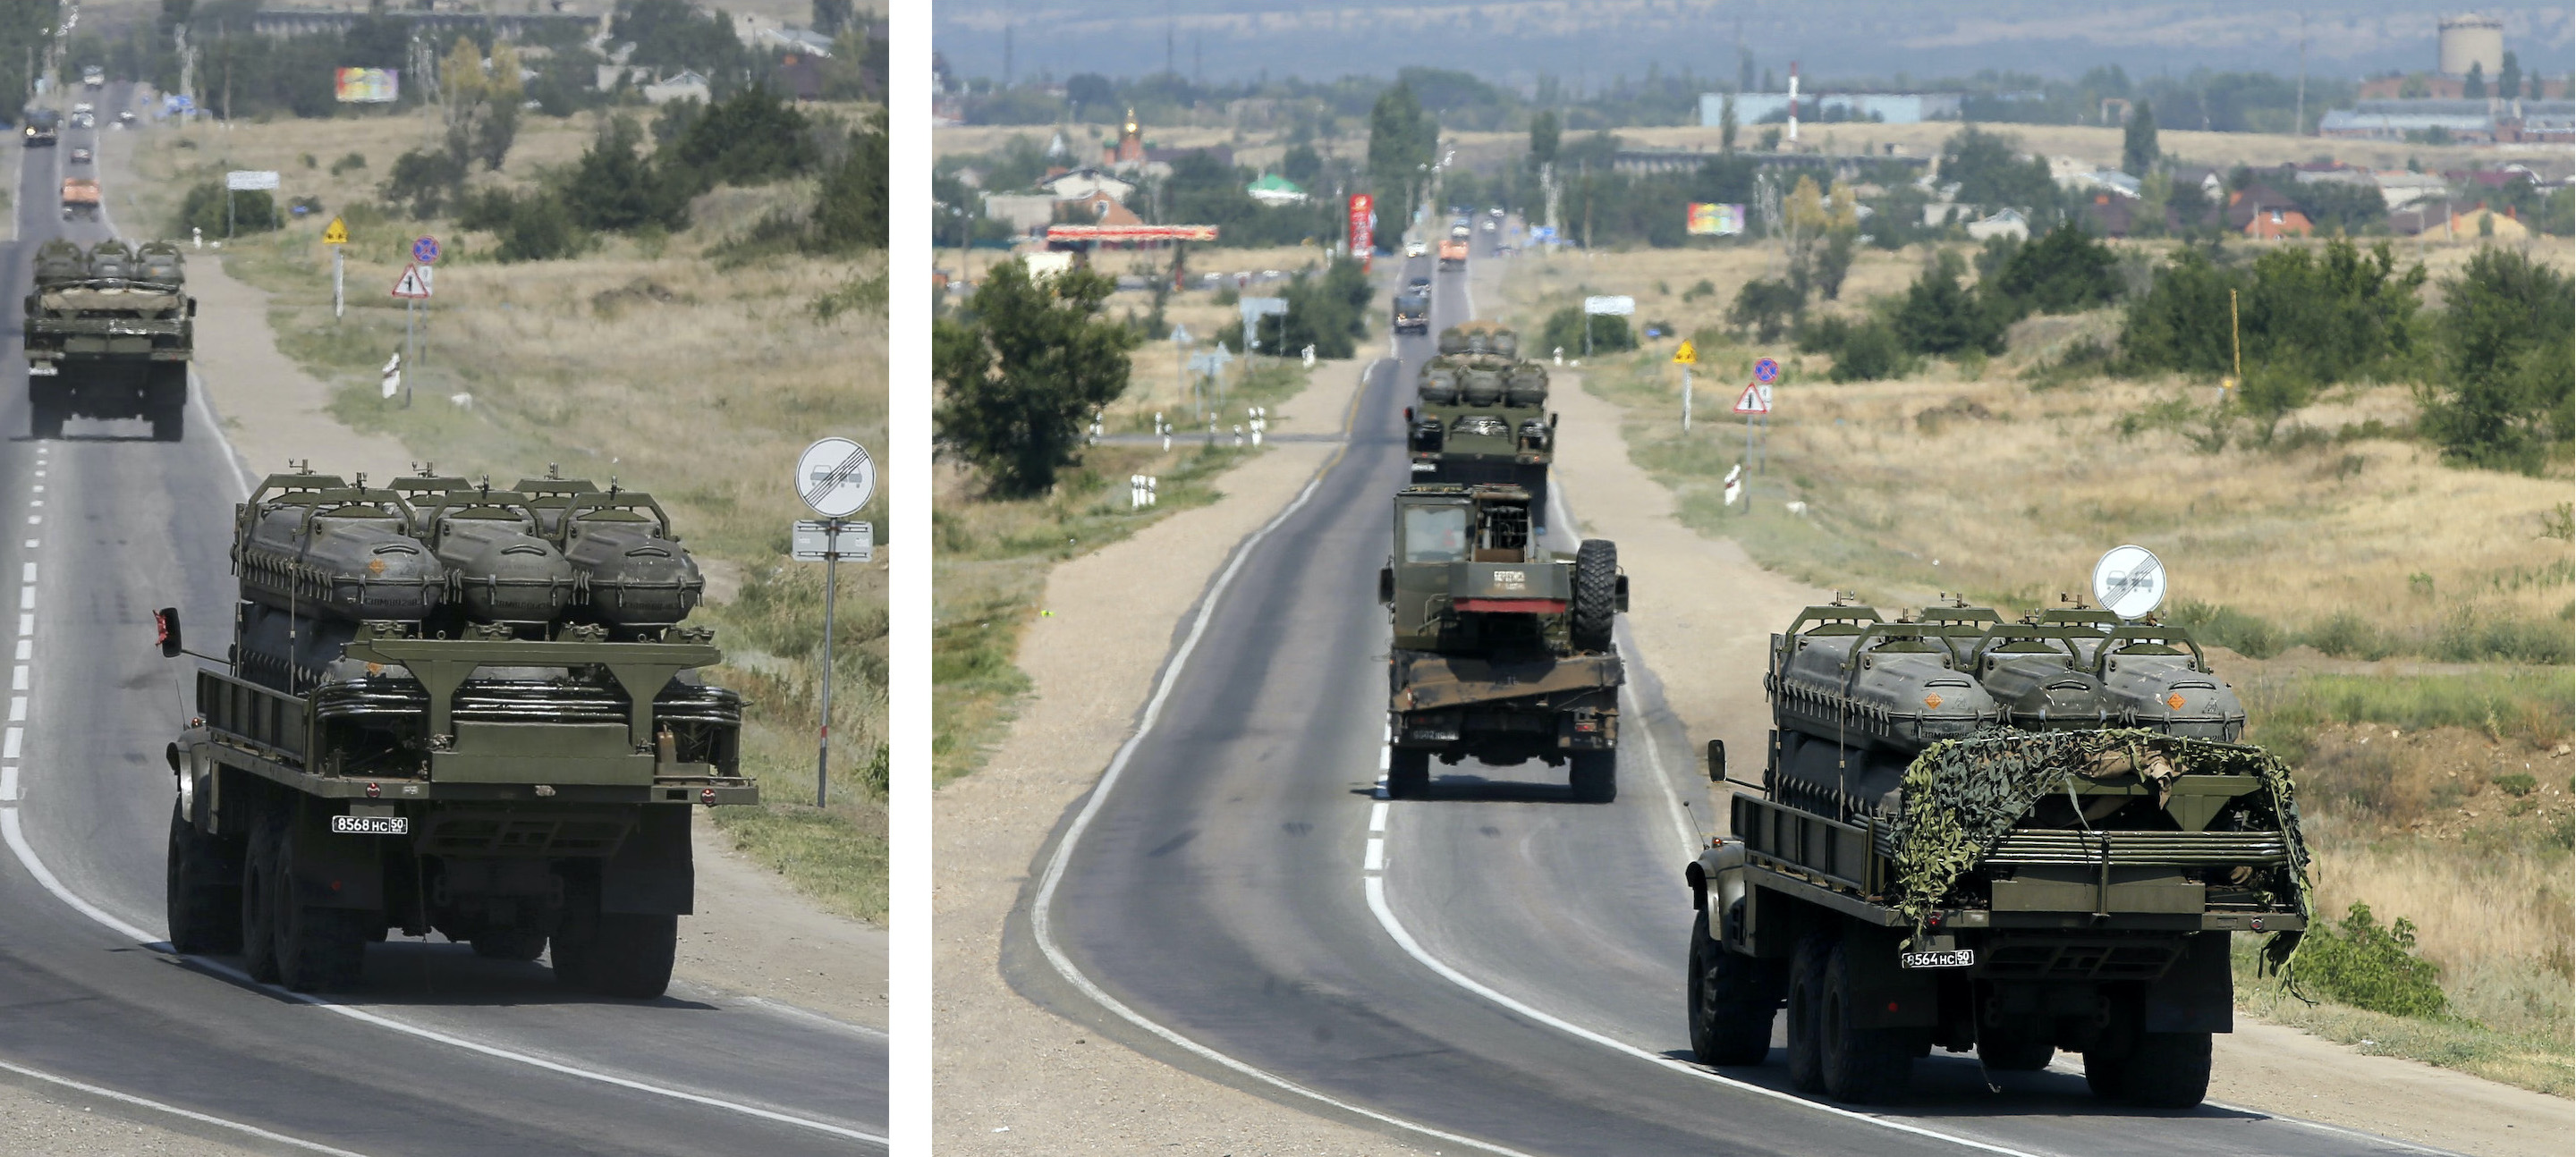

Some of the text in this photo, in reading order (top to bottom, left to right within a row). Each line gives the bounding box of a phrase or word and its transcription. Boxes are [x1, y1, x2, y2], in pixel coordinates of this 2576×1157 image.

[338, 817, 369, 831] 8568
[391, 819, 403, 828] 50
[1907, 953, 1938, 966] 8564
[1957, 951, 1970, 961] 50
